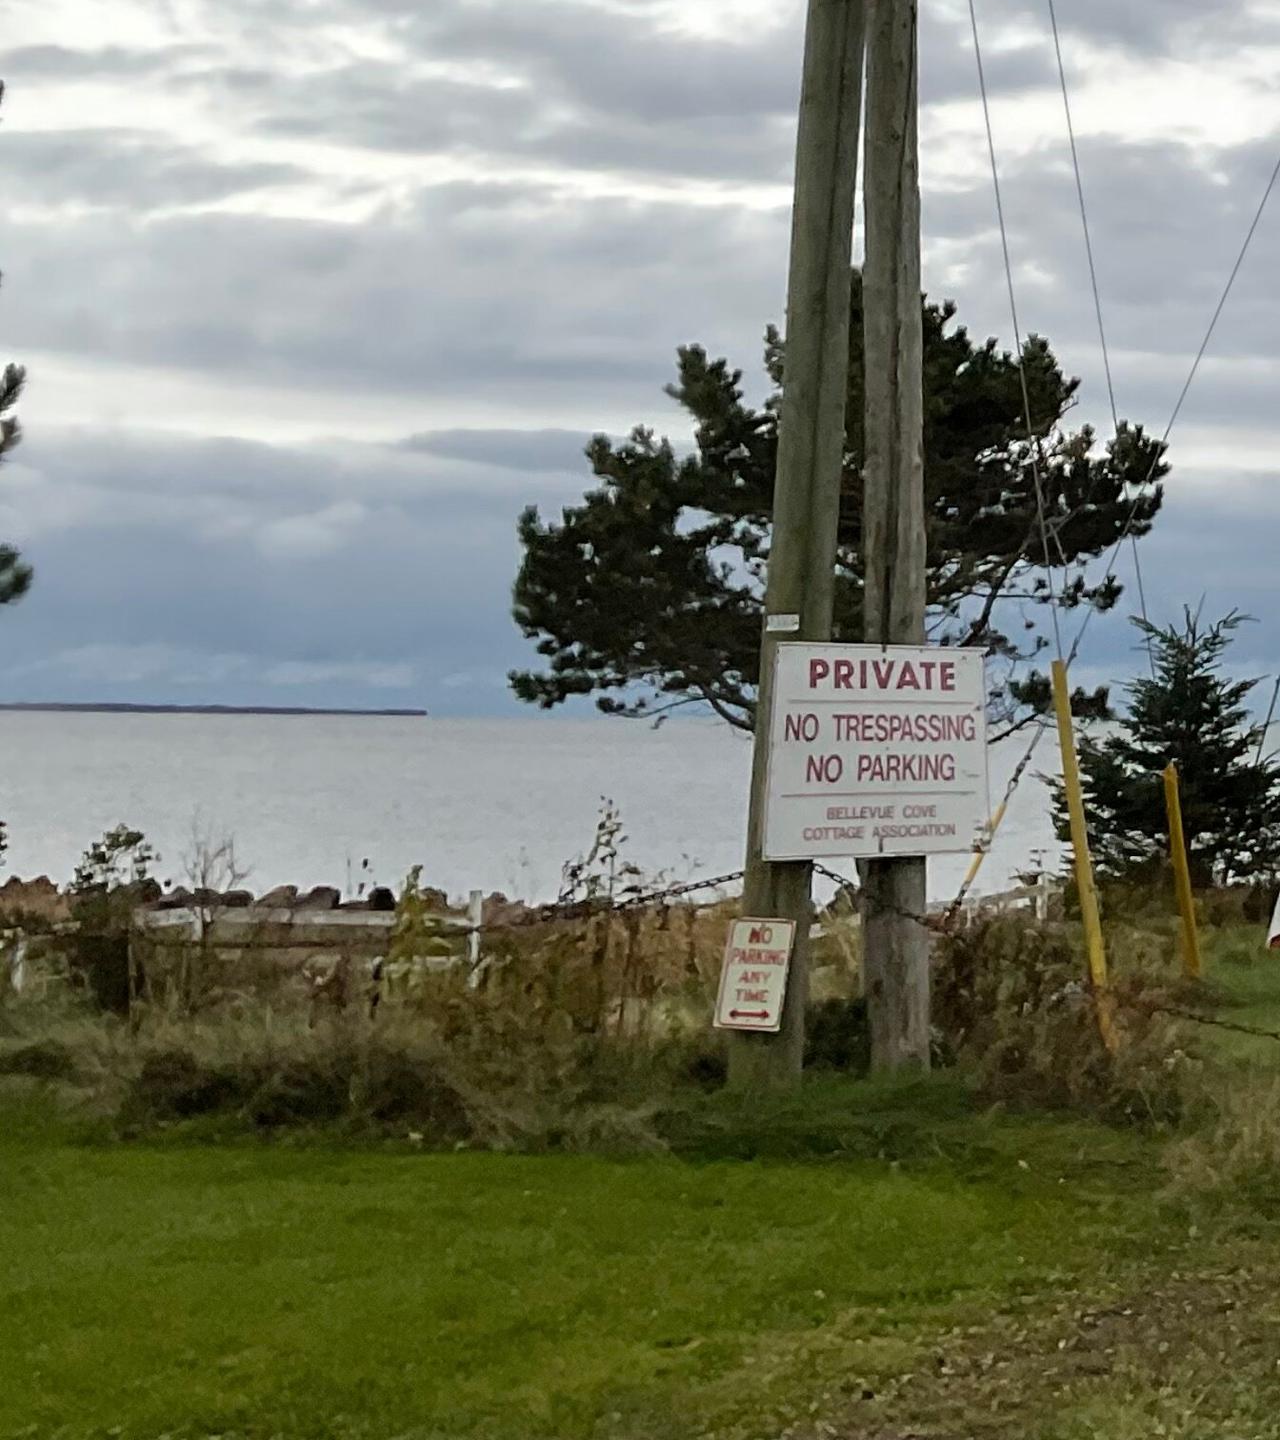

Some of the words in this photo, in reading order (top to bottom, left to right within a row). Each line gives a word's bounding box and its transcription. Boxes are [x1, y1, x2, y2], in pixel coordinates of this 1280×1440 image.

[809, 658, 956, 691] PRIVATE
[784, 713, 820, 742] NO
[832, 713, 976, 742] TRESPASSING
[806, 754, 843, 783] NO
[857, 753, 955, 781] PARKING
[826, 805, 895, 820] BELLEVUE
[902, 804, 937, 818] COVE
[803, 826, 864, 841] COTTAGE
[872, 823, 956, 839] ASSOCIATION
[748, 927, 773, 944] NO
[733, 948, 786, 965] PARKING
[738, 970, 771, 984] ANY
[735, 989, 769, 1003] TIME
